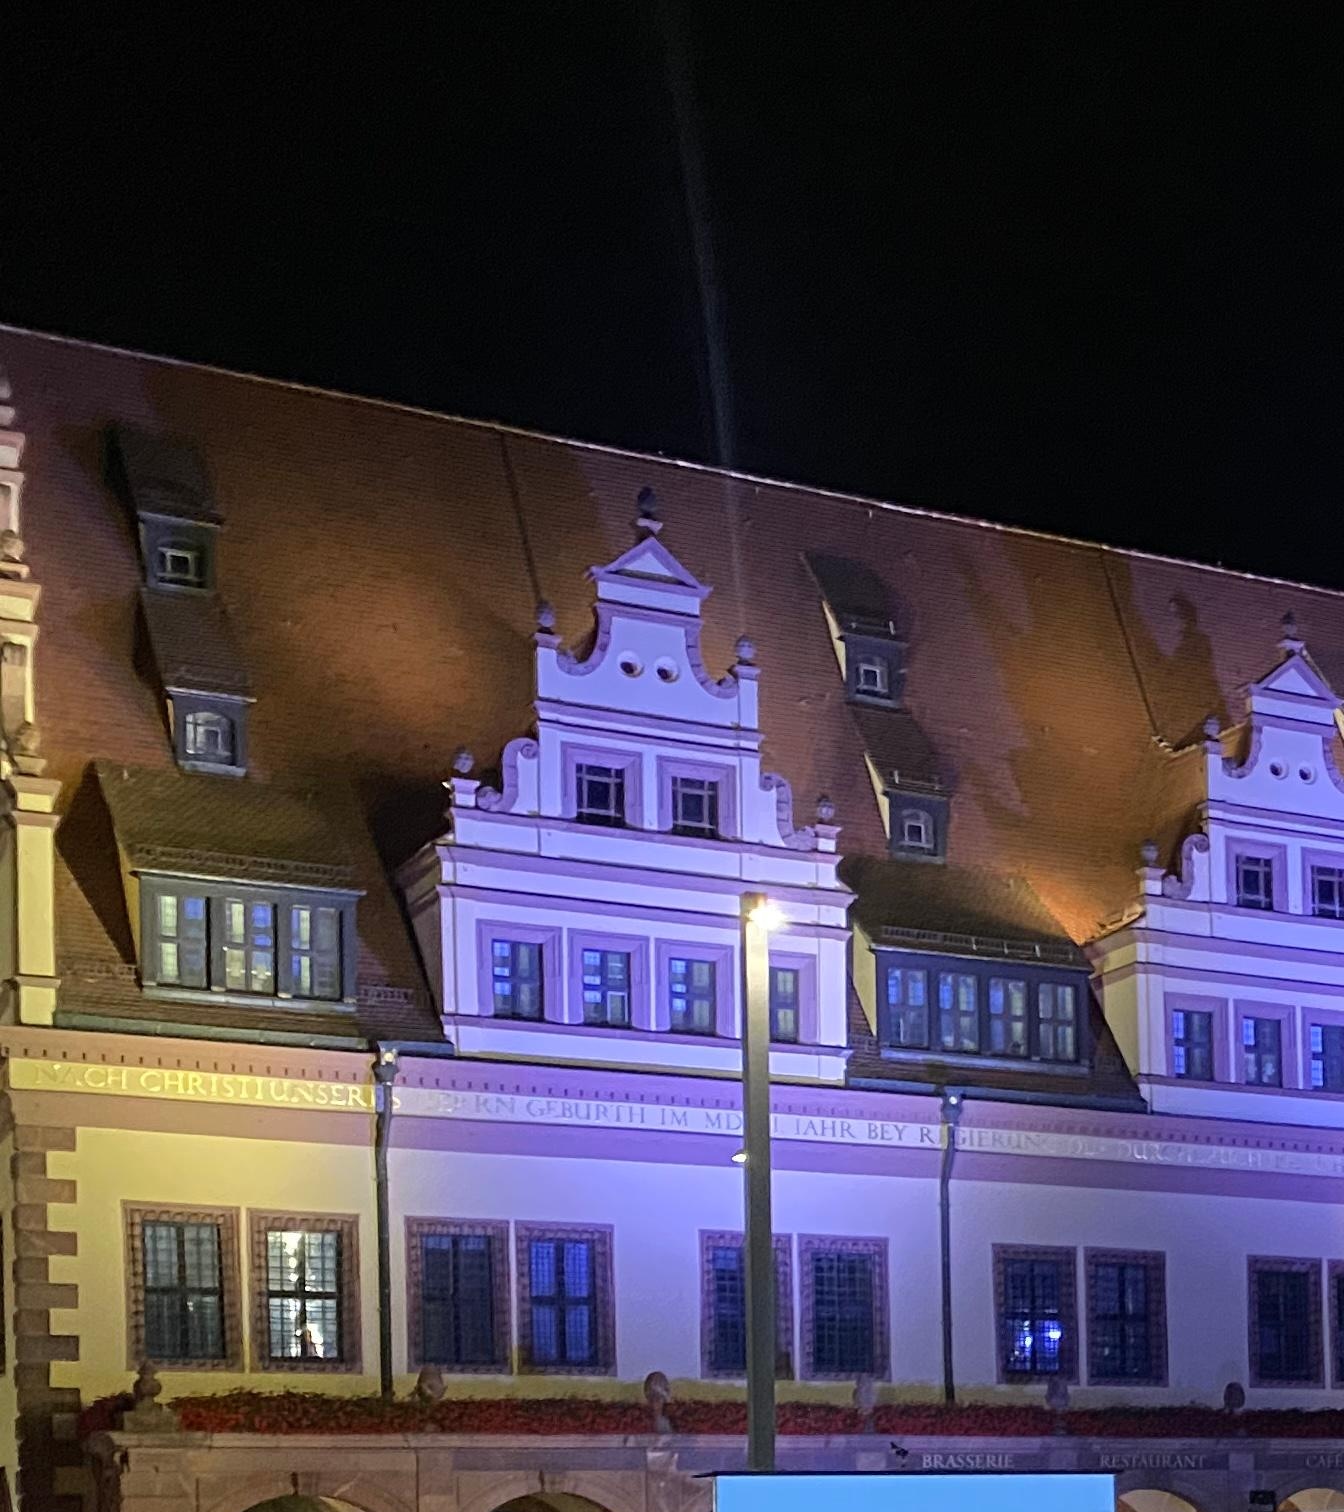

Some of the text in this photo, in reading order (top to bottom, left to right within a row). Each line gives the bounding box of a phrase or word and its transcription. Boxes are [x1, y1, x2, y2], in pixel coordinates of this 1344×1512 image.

[34, 1062, 128, 1091] NACH
[139, 1070, 262, 1099] CHRISTI
[527, 1098, 647, 1126] GEBURTH
[660, 1105, 690, 1127] IM
[793, 1117, 855, 1139] IAHR
[867, 1121, 906, 1143] BEY
[921, 1453, 1016, 1470] BRASSERIE
[1099, 1454, 1207, 1470] RESTAURANT
[1305, 1450, 1344, 1470] CAFÉ
